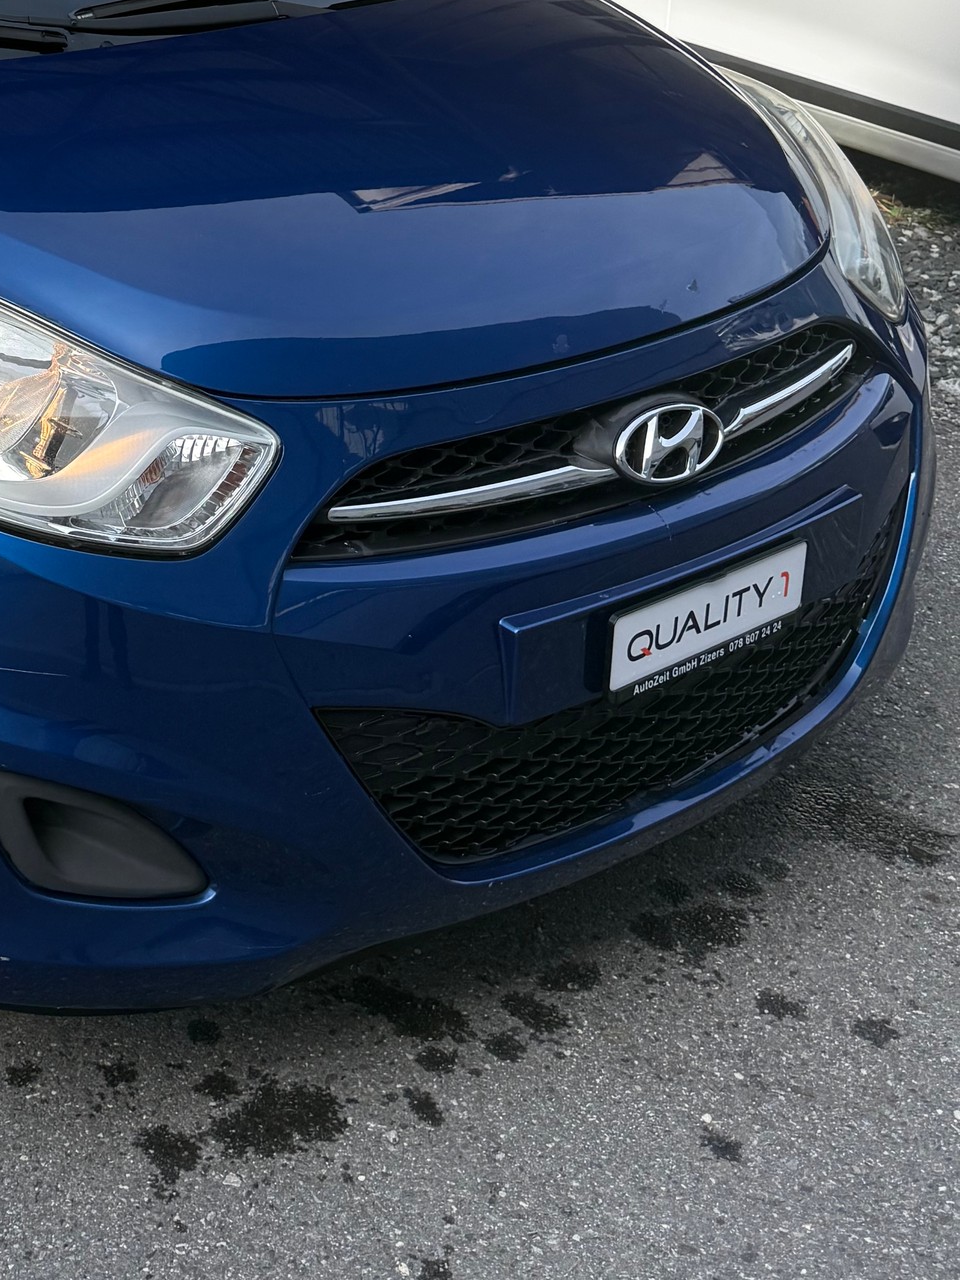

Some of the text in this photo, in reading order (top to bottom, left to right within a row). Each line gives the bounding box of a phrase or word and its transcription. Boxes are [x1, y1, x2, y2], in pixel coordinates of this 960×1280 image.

[633, 620, 782, 696] AutoZeit GmbH Zizers 078 607 24 24
